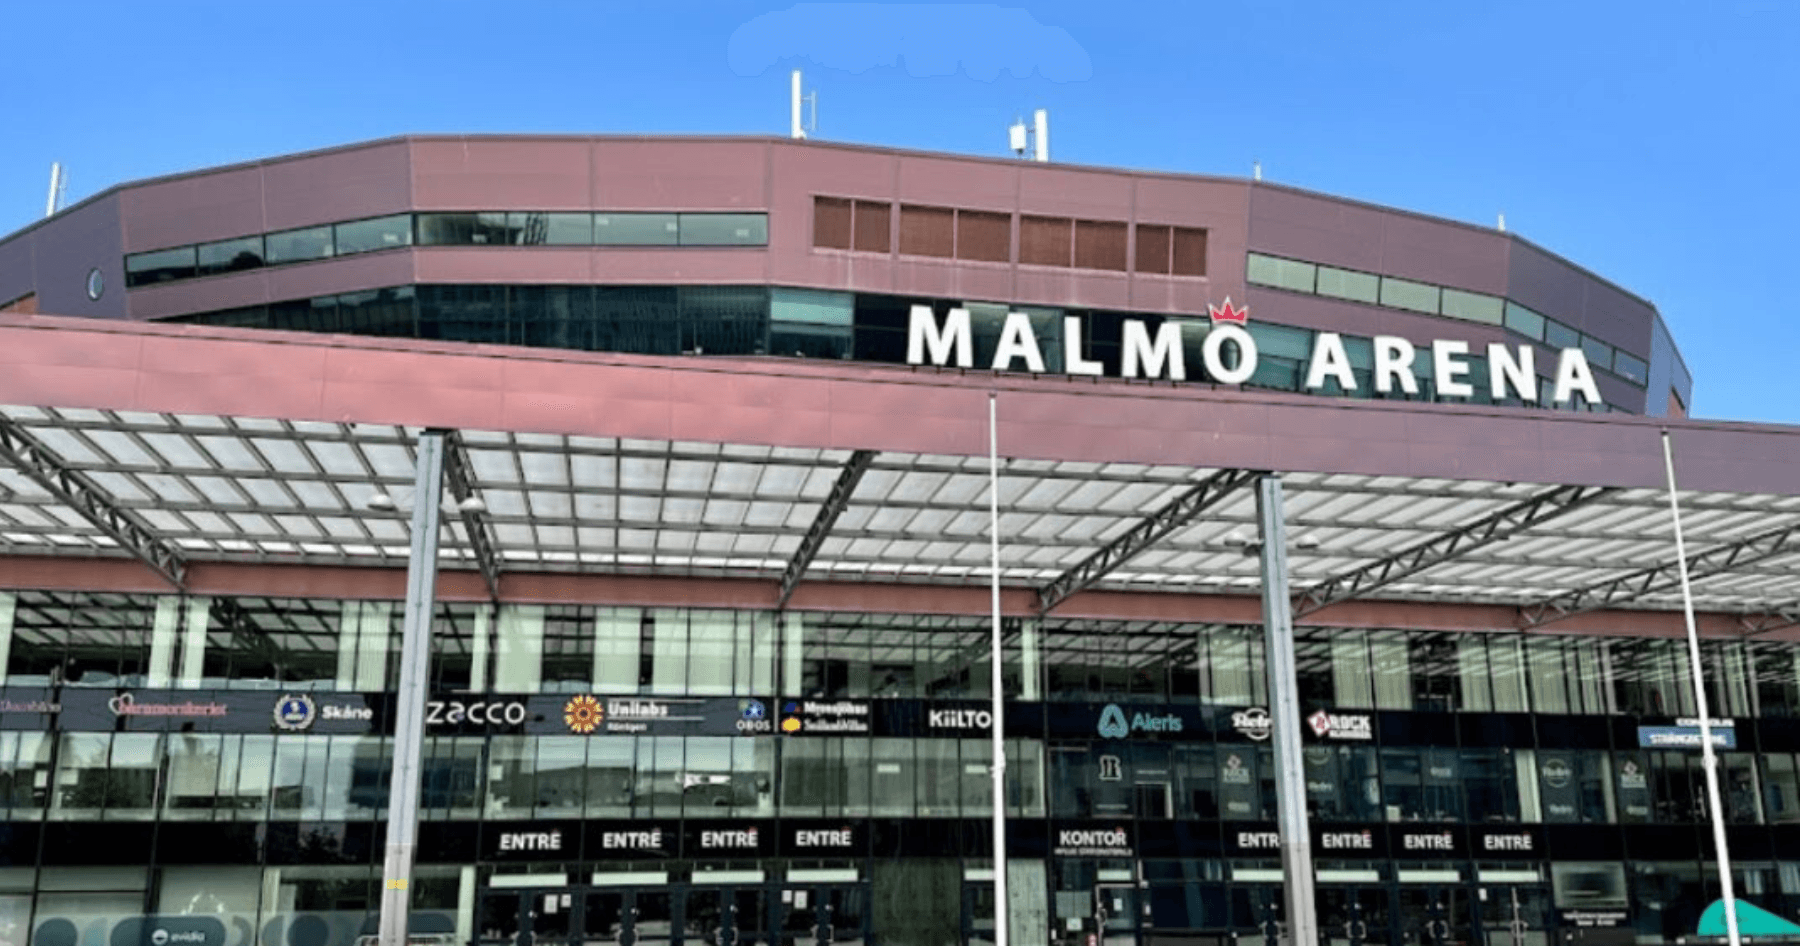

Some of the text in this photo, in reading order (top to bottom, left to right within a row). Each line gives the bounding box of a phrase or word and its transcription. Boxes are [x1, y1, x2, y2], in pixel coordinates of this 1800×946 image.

[1306, 332, 1602, 404] ARENA
[321, 704, 373, 720] Skåne
[607, 701, 669, 716] Unilabs
[736, 720, 770, 731] OBOS
[1131, 712, 1183, 731] Aleris
[1231, 711, 1273, 727] Retr
[1059, 831, 1127, 846] KONTOR
[1238, 833, 1280, 848] ENTR
